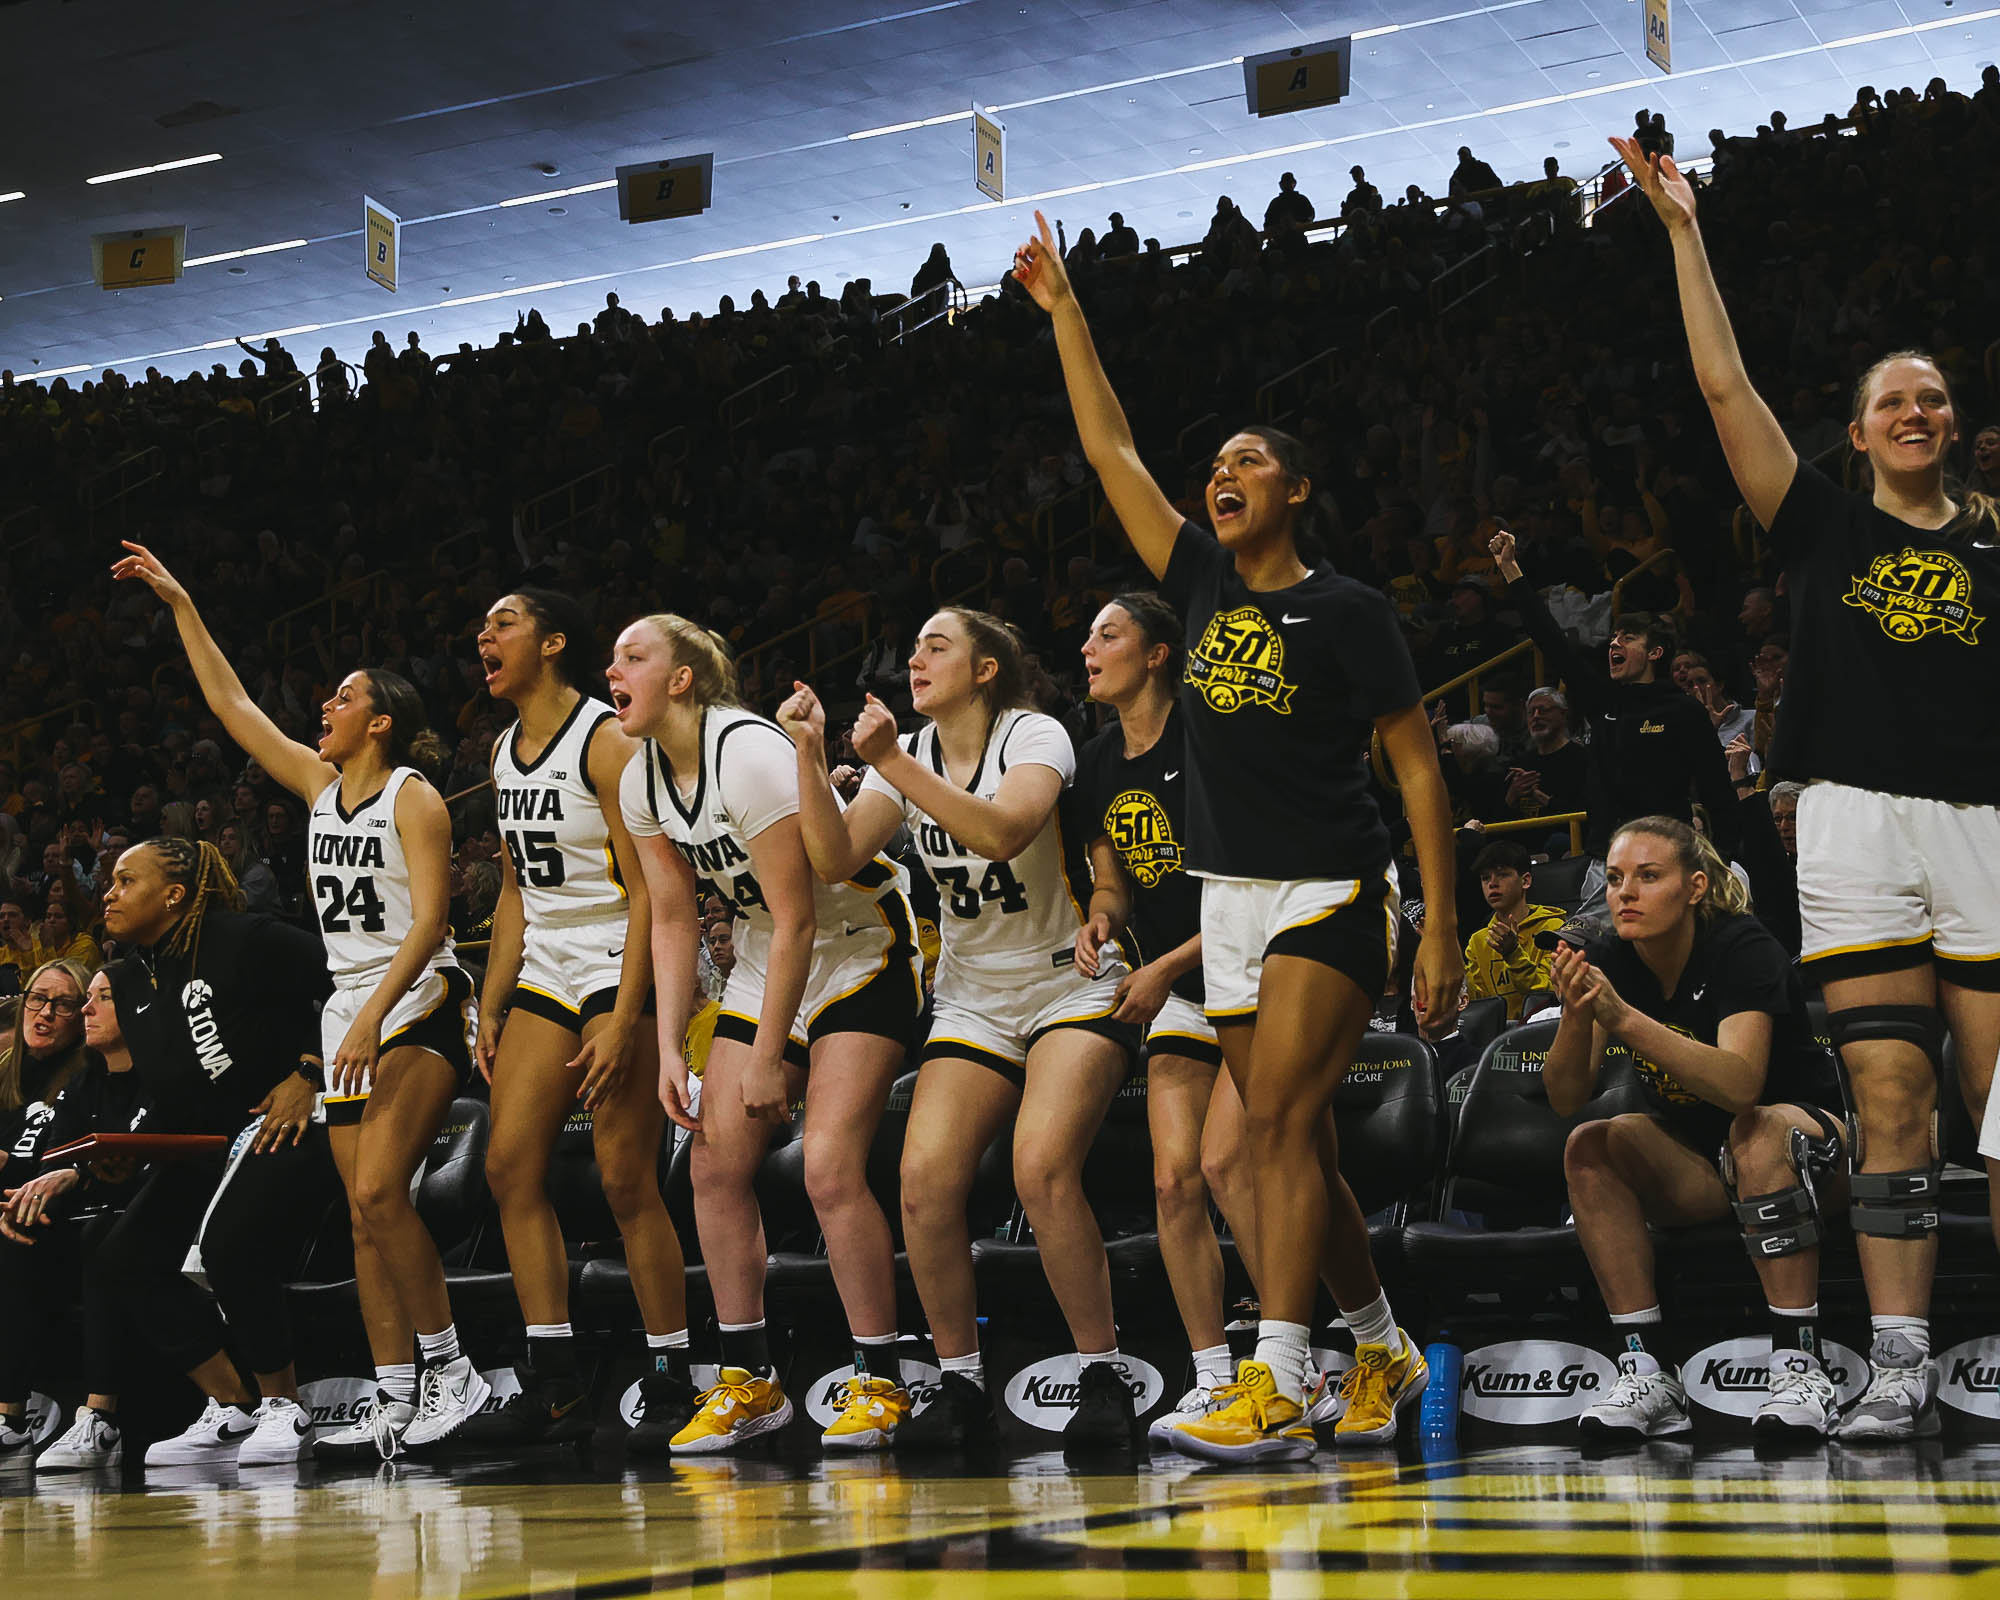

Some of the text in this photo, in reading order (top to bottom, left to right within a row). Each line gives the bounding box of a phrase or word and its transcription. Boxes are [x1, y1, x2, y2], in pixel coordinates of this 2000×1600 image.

[1650, 14, 1665, 44] AA
[1288, 65, 1308, 92] A
[985, 151, 994, 174] A
[656, 178, 675, 200] B
[129, 248, 146, 269] C
[377, 241, 387, 264] B
[1862, 586, 1964, 619] 1973 years 2023
[1207, 664, 1249, 684] years
[1257, 675, 1276, 689] 2023
[499, 788, 565, 821] OWA
[1112, 809, 1154, 848] 50
[312, 832, 385, 869] IOWA
[316, 874, 386, 934] 24
[932, 861, 1029, 919] 34
[187, 1007, 233, 1080] IOWA
[1353, 1072, 1384, 1083] CARE
[1382, 1057, 1413, 1071] IOWA
